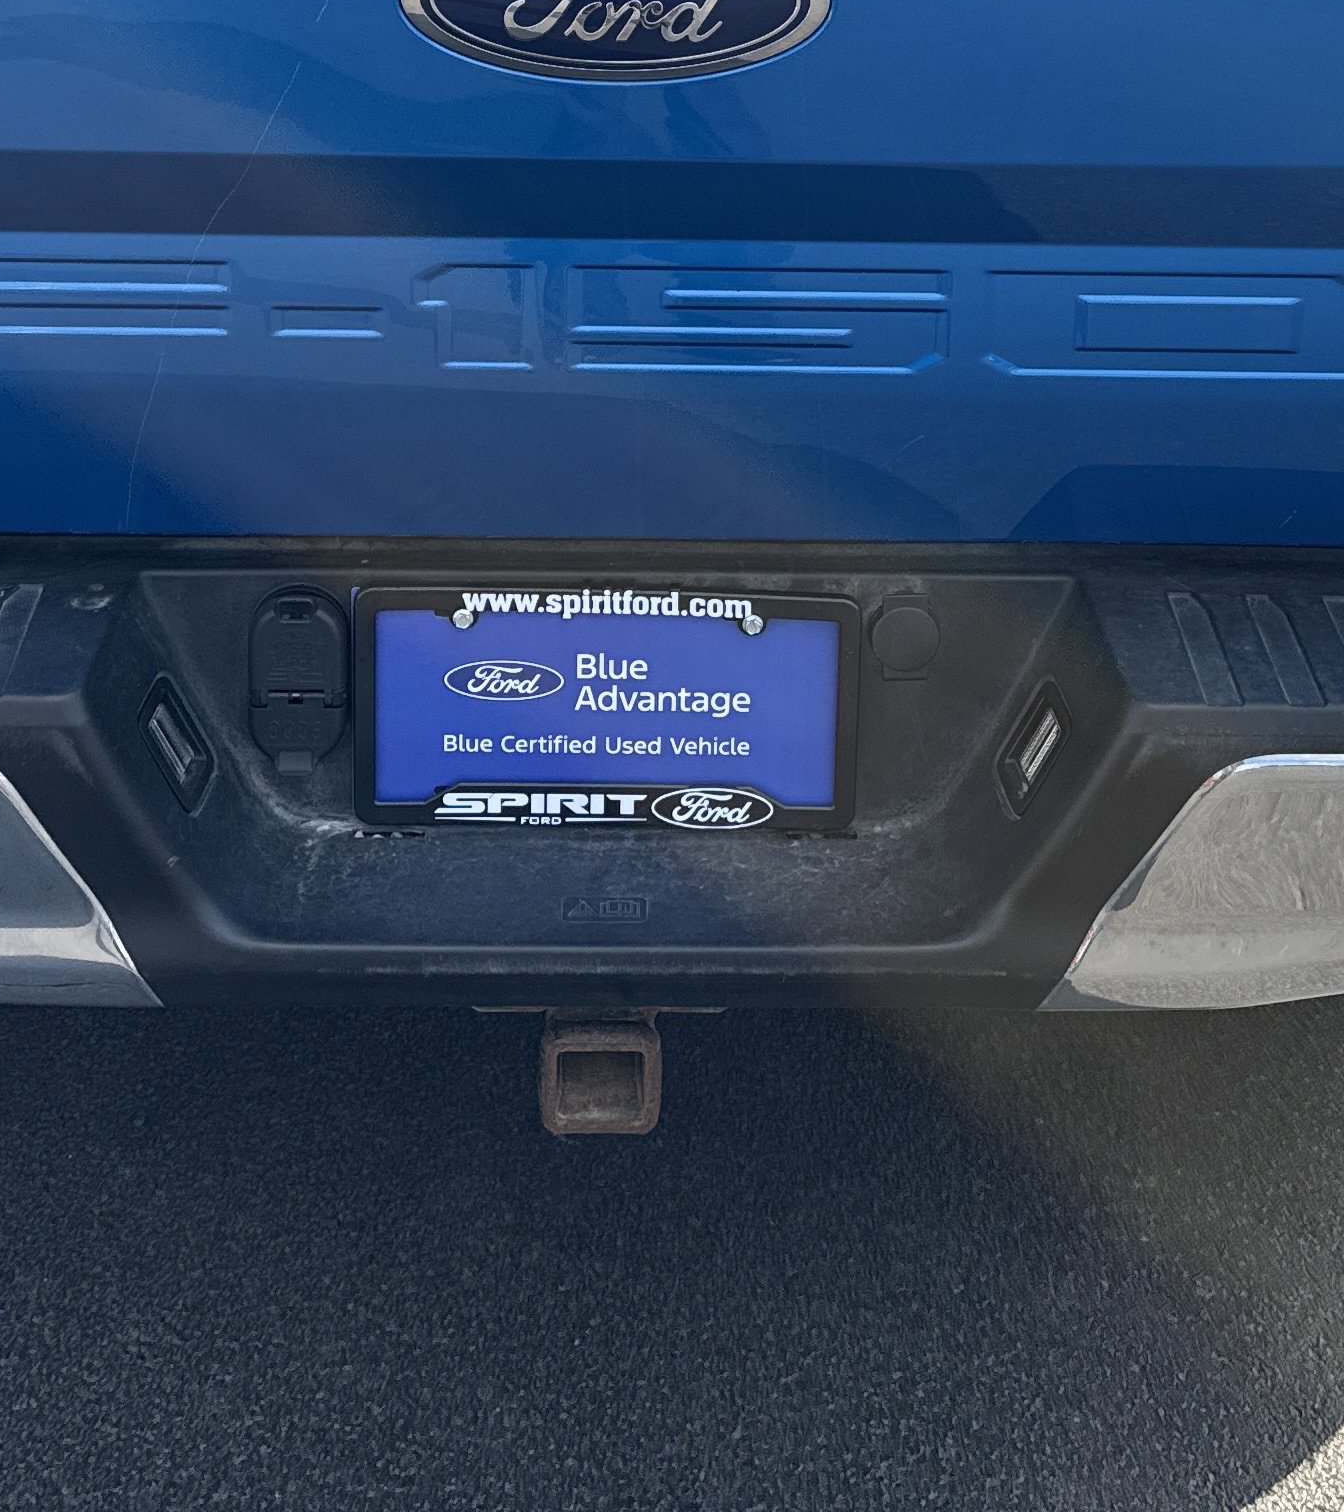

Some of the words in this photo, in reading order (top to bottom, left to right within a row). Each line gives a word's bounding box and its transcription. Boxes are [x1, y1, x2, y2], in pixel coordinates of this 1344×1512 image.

[462, 589, 752, 619] www.spiritford.com
[467, 665, 541, 694] Ford
[576, 653, 648, 680] Blue
[574, 685, 751, 717] Advantage
[443, 734, 493, 753] Blue
[501, 734, 597, 755] Certified
[605, 736, 662, 755] Used
[670, 736, 750, 756] Vehicle
[434, 793, 648, 815] SPIRIT
[672, 792, 754, 823] Ford
[520, 816, 562, 825] FORD
